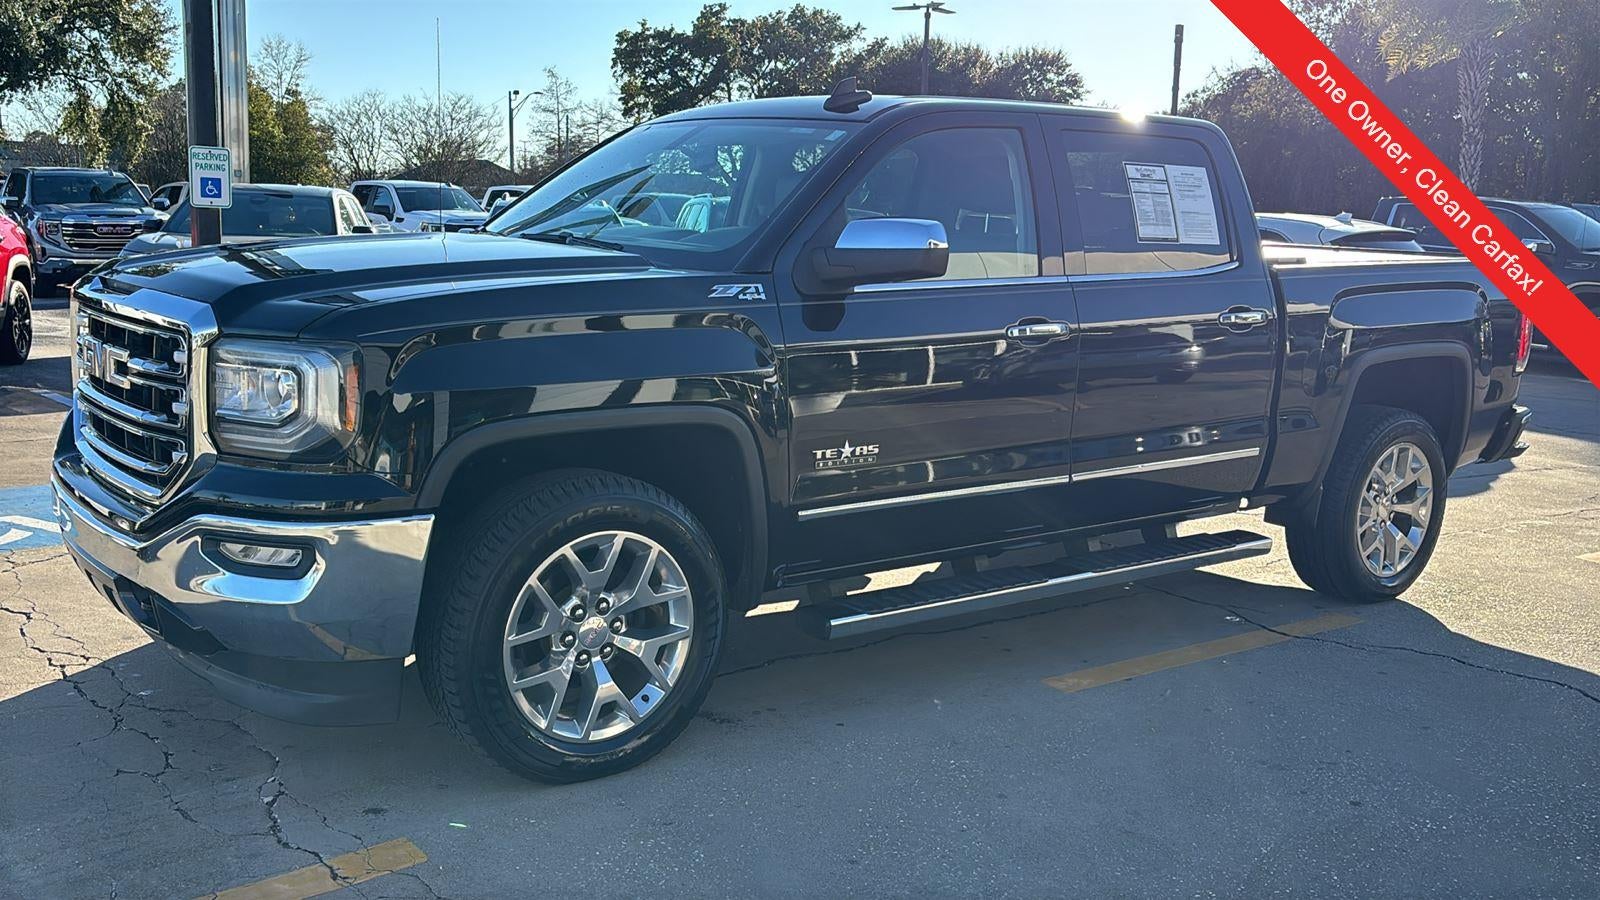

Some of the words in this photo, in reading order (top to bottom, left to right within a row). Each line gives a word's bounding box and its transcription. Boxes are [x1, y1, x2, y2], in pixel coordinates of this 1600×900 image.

[192, 152, 228, 162] RESERVED
[195, 162, 226, 172] PARKING
[96, 226, 132, 234] GMC
[818, 457, 874, 468] EDITION
